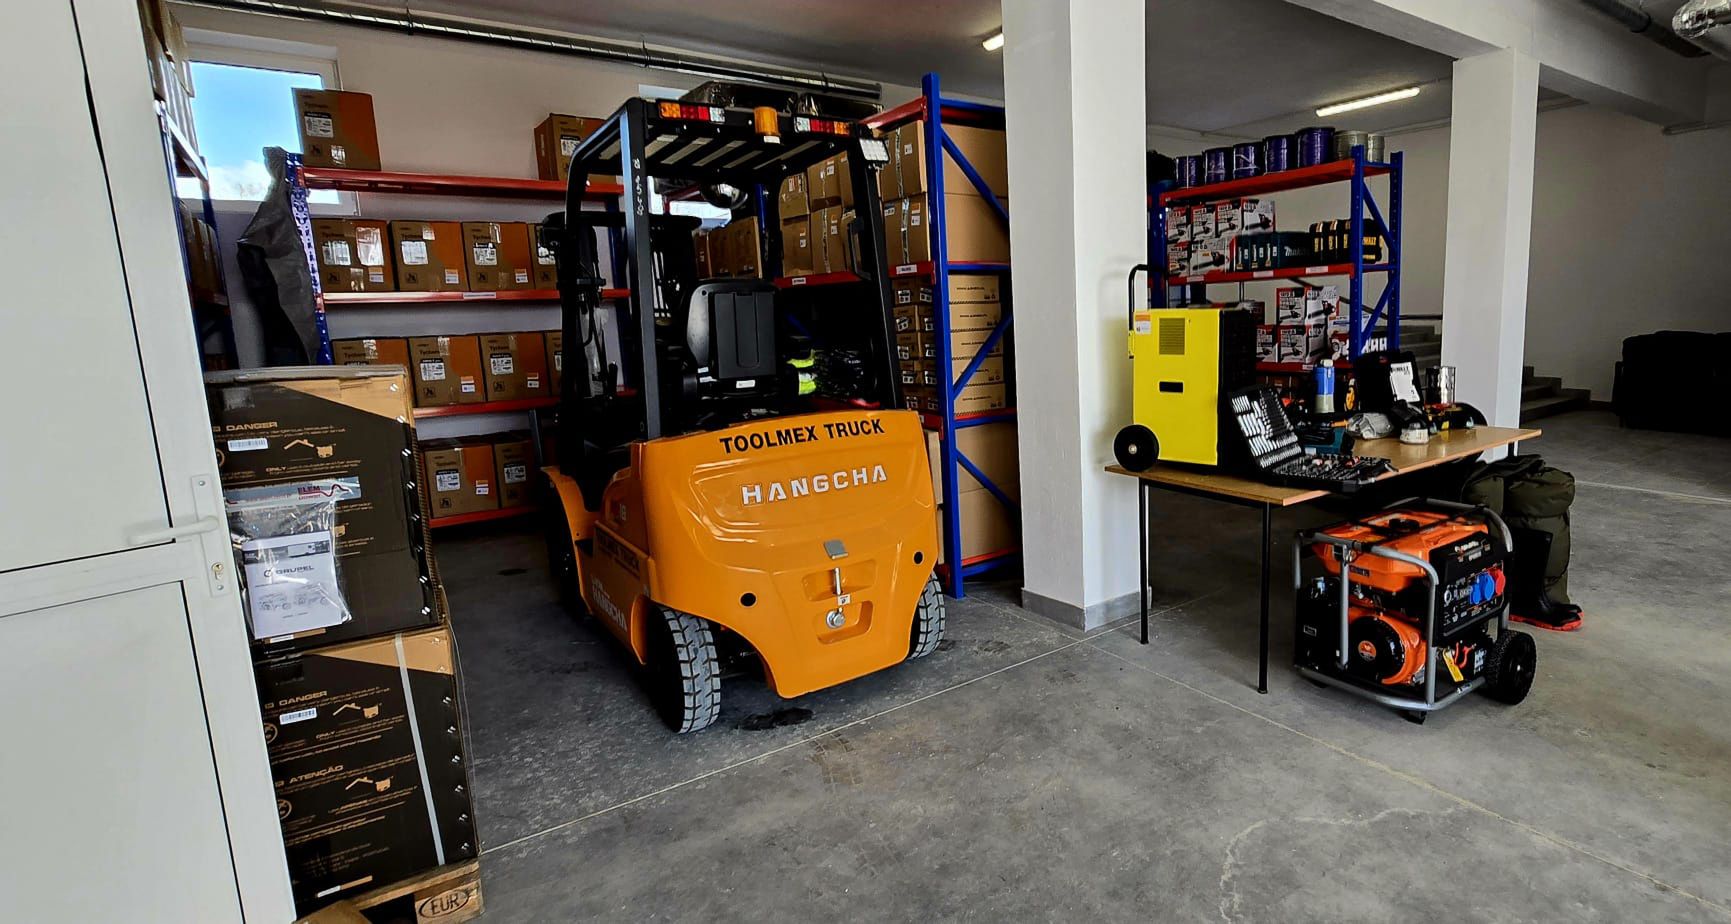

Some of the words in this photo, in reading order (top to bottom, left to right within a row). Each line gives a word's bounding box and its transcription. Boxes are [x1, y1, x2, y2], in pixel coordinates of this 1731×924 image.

[225, 421, 278, 432] DANGER
[719, 425, 819, 454] TOOLMEX
[823, 418, 885, 439] TRUCK
[740, 464, 888, 506] HANGCHA
[278, 690, 328, 706] DANGER
[288, 764, 345, 784] ATENÇÃO
[430, 892, 460, 916] EUR
